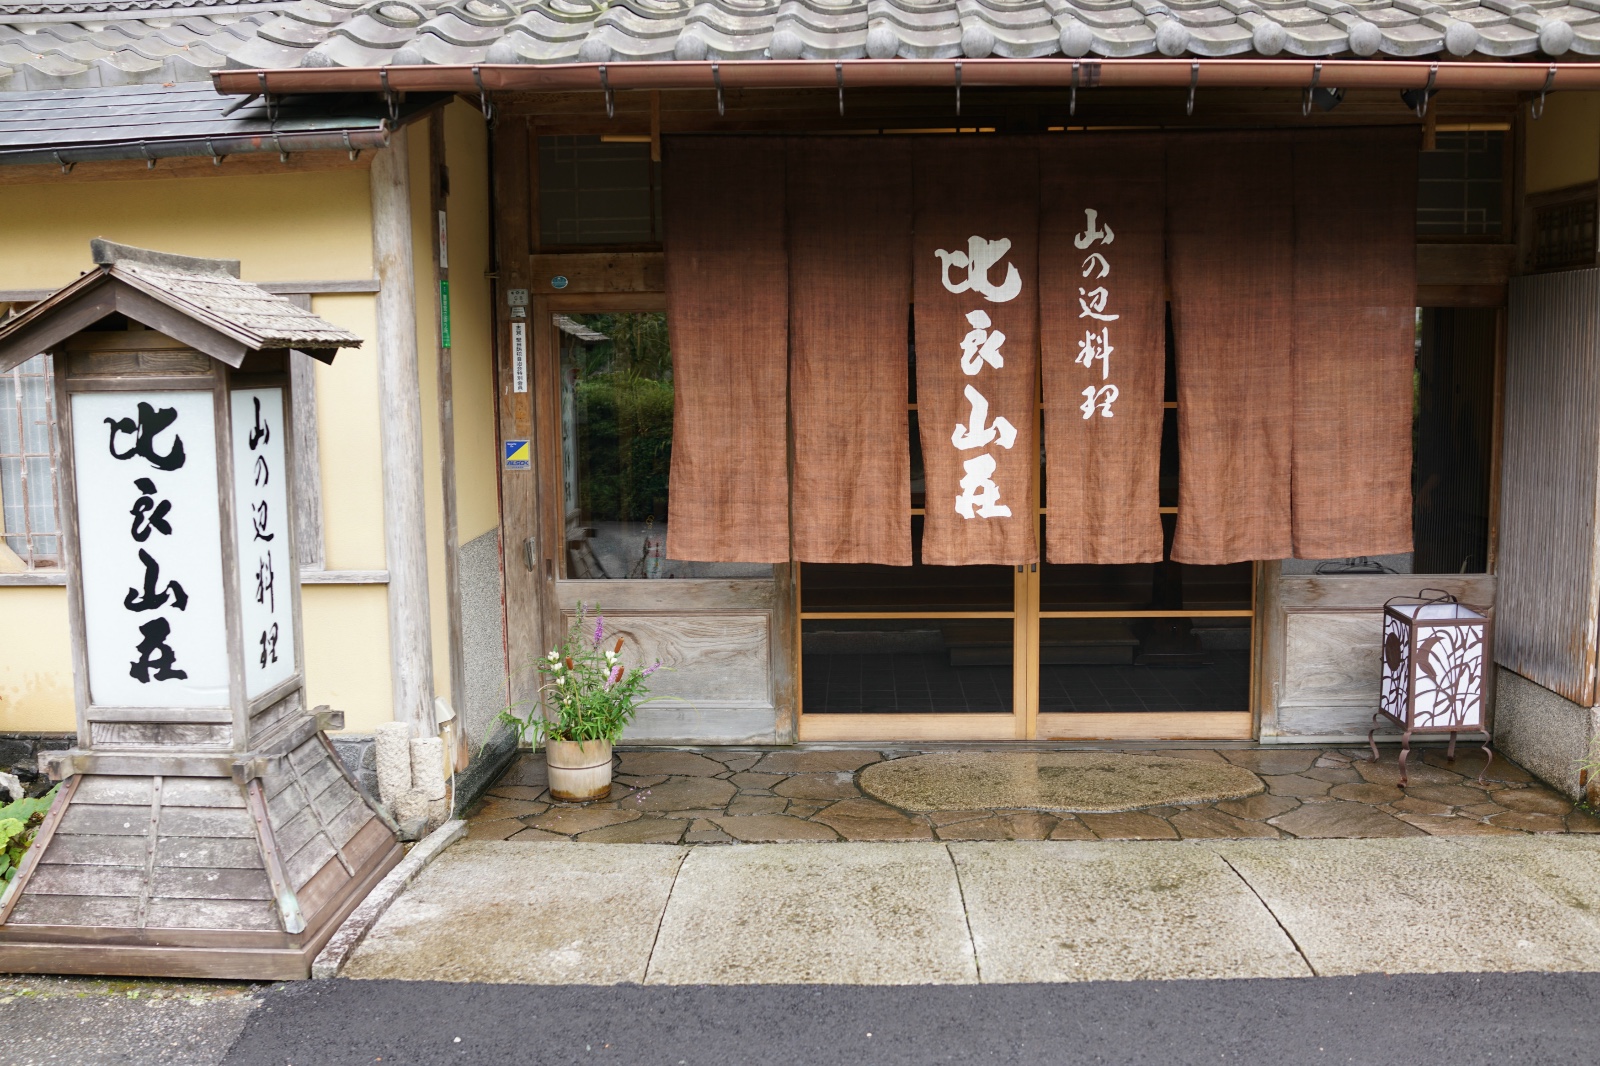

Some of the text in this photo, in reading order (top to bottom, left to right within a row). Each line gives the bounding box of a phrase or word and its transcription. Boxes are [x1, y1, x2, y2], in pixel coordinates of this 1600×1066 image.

[934, 235, 1023, 520] 比良山荘
[1073, 208, 1120, 420] 山の辺料理
[103, 401, 189, 684] 比良山荘
[248, 395, 280, 670] 山の辺料理
